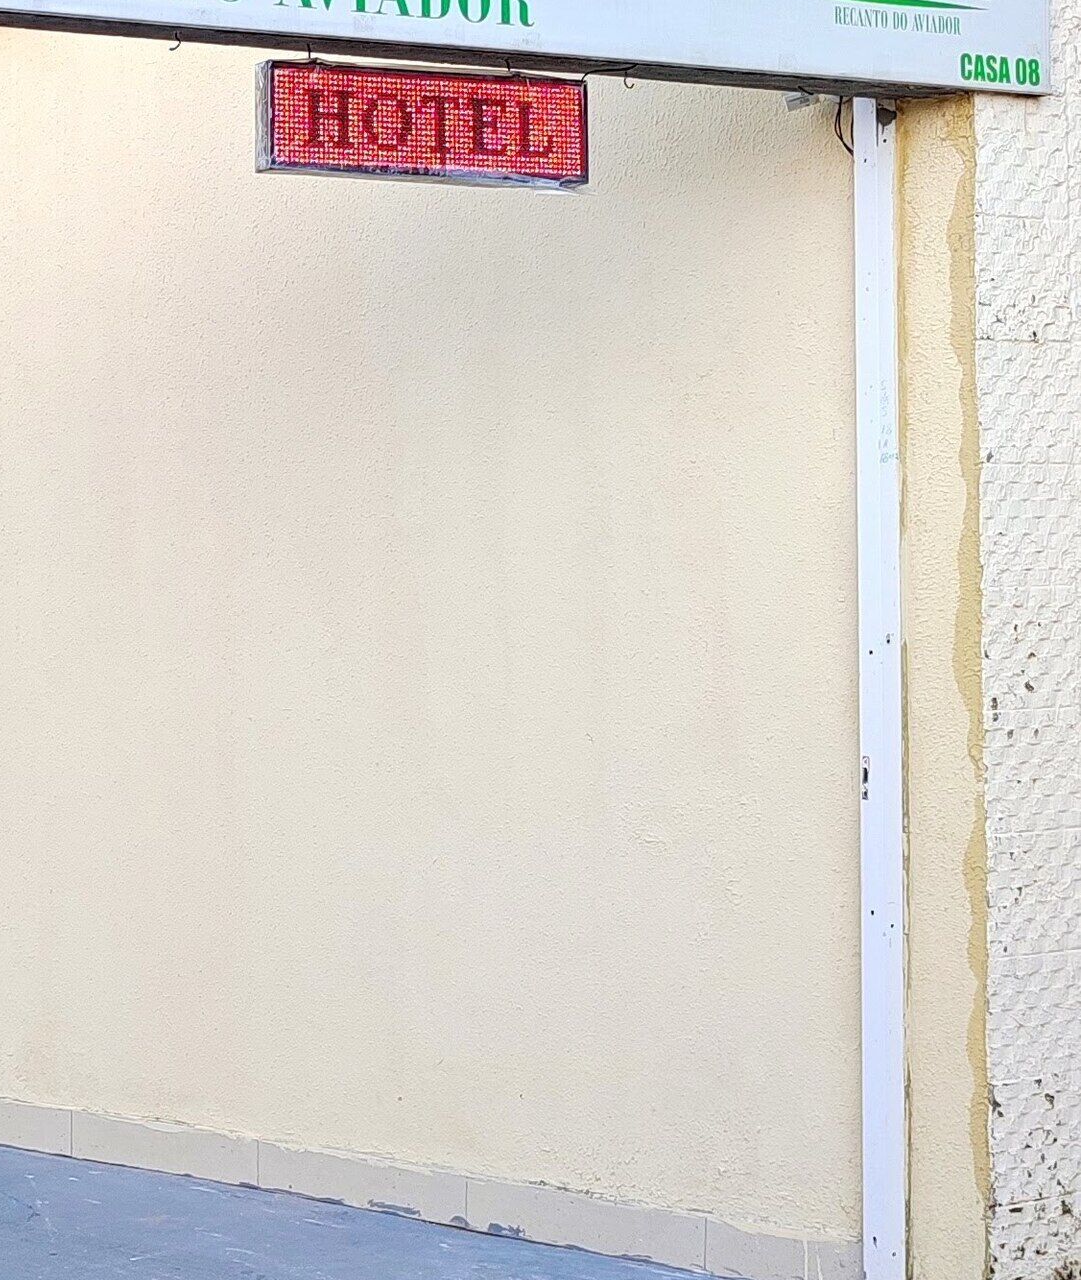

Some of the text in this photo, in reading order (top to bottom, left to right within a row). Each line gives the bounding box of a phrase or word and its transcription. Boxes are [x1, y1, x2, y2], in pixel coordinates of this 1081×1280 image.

[834, 6, 962, 36] RECANTO DO AVIADOR
[960, 52, 1041, 87] CASA 08
[306, 88, 556, 158] HOTEL
